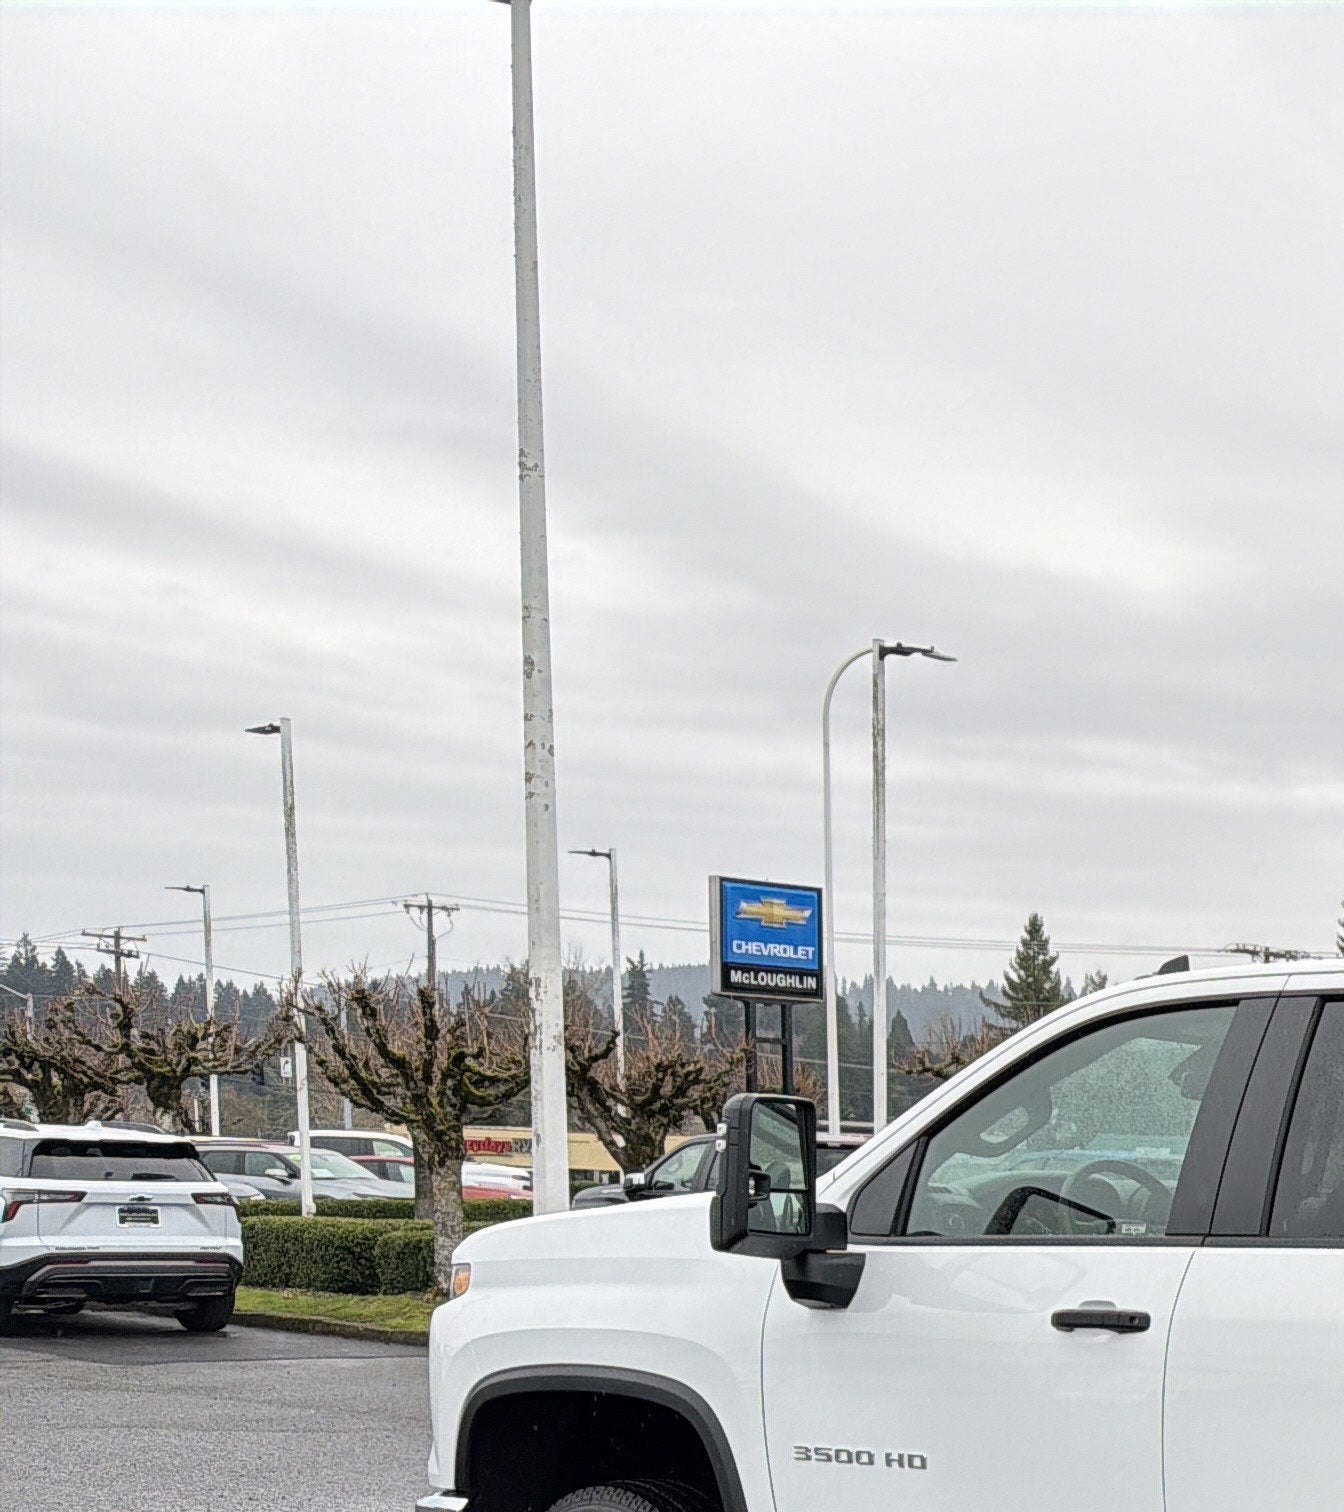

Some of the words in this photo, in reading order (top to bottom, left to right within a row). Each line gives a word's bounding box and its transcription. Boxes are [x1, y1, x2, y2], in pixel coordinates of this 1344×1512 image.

[732, 939, 815, 960] CHEVROLET
[730, 969, 817, 989] McLOUGHLIN
[793, 1445, 875, 1466] 3500
[884, 1452, 928, 1470] HD
